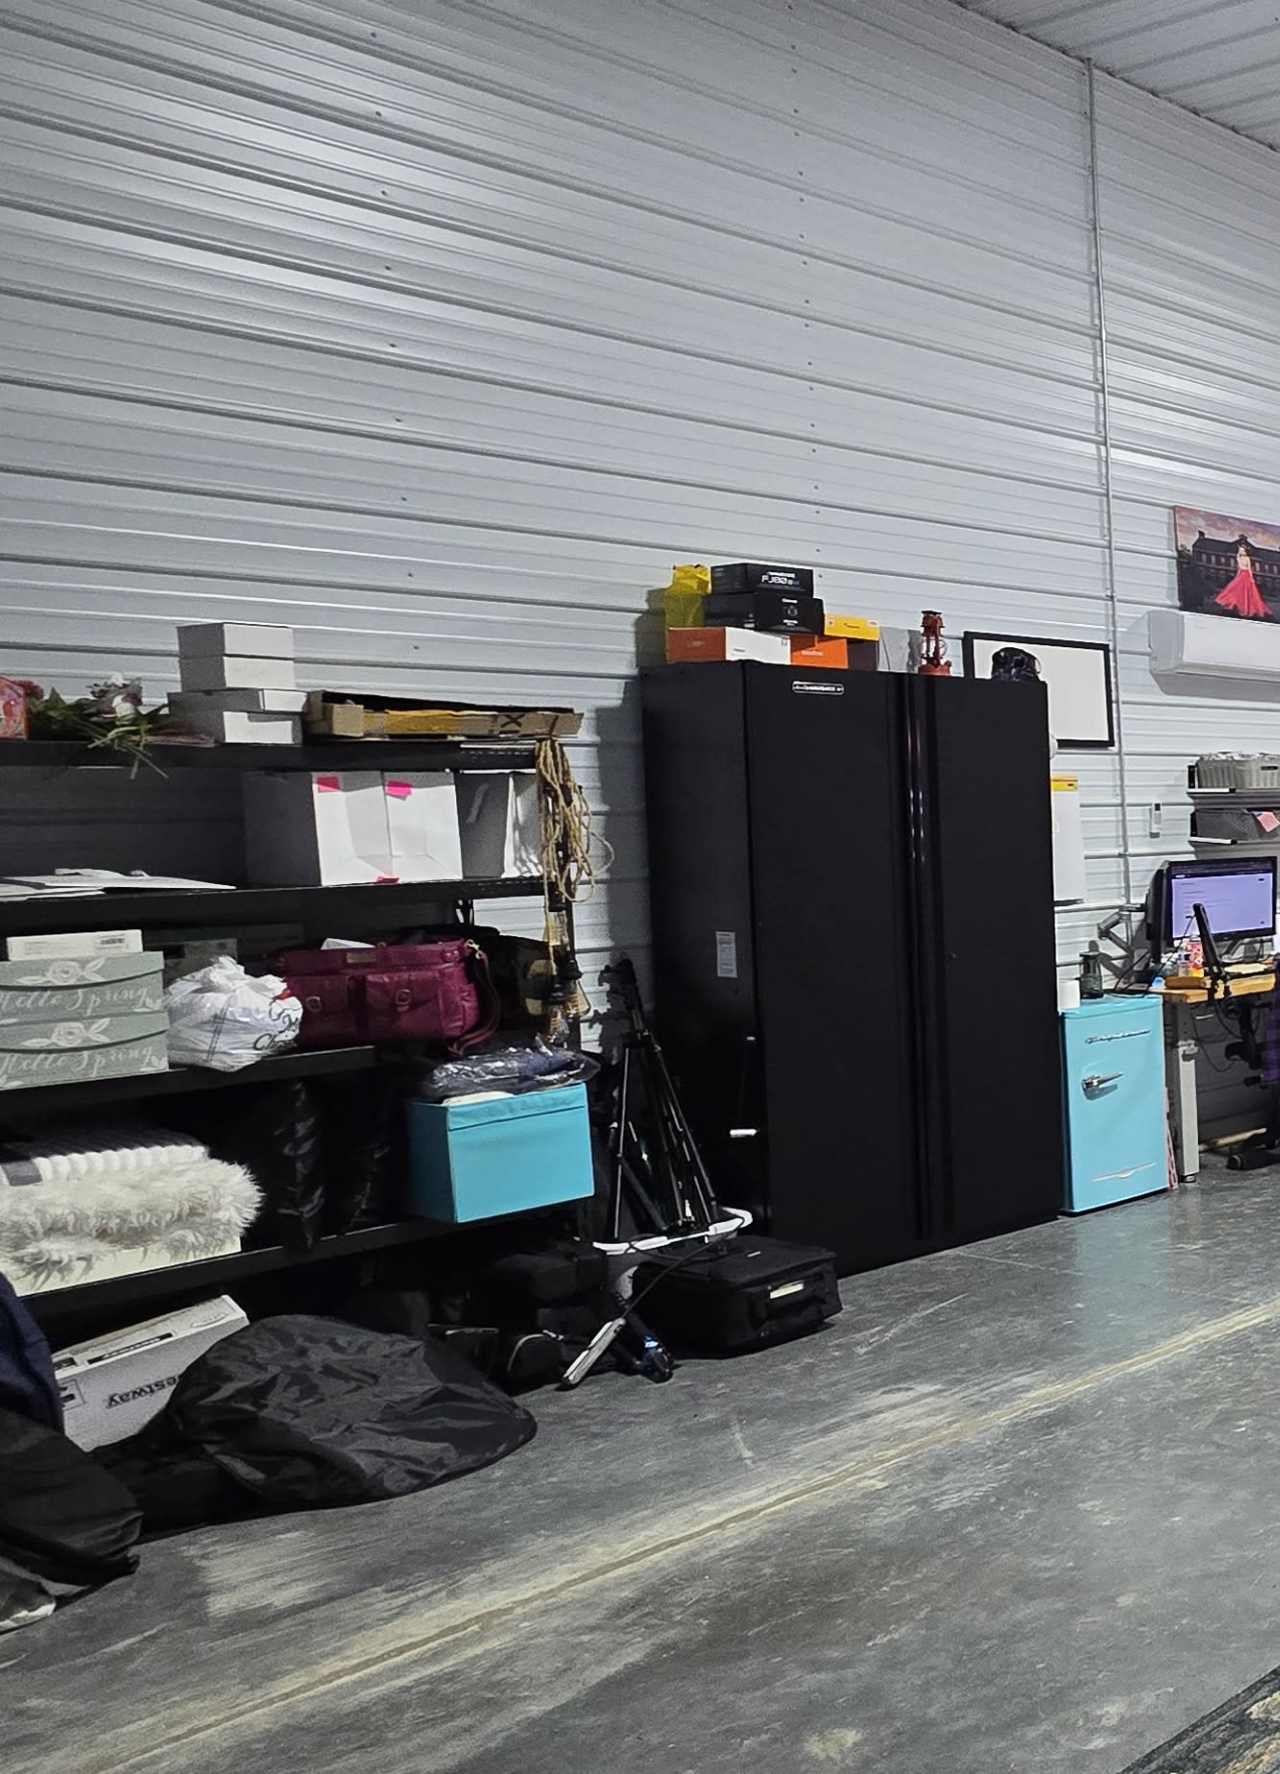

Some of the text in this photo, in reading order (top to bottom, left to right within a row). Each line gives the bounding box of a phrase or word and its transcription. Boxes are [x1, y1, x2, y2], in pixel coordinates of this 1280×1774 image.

[66, 986, 149, 1016] Spring
[71, 1047, 152, 1077] Spring
[105, 1374, 179, 1409] estway
